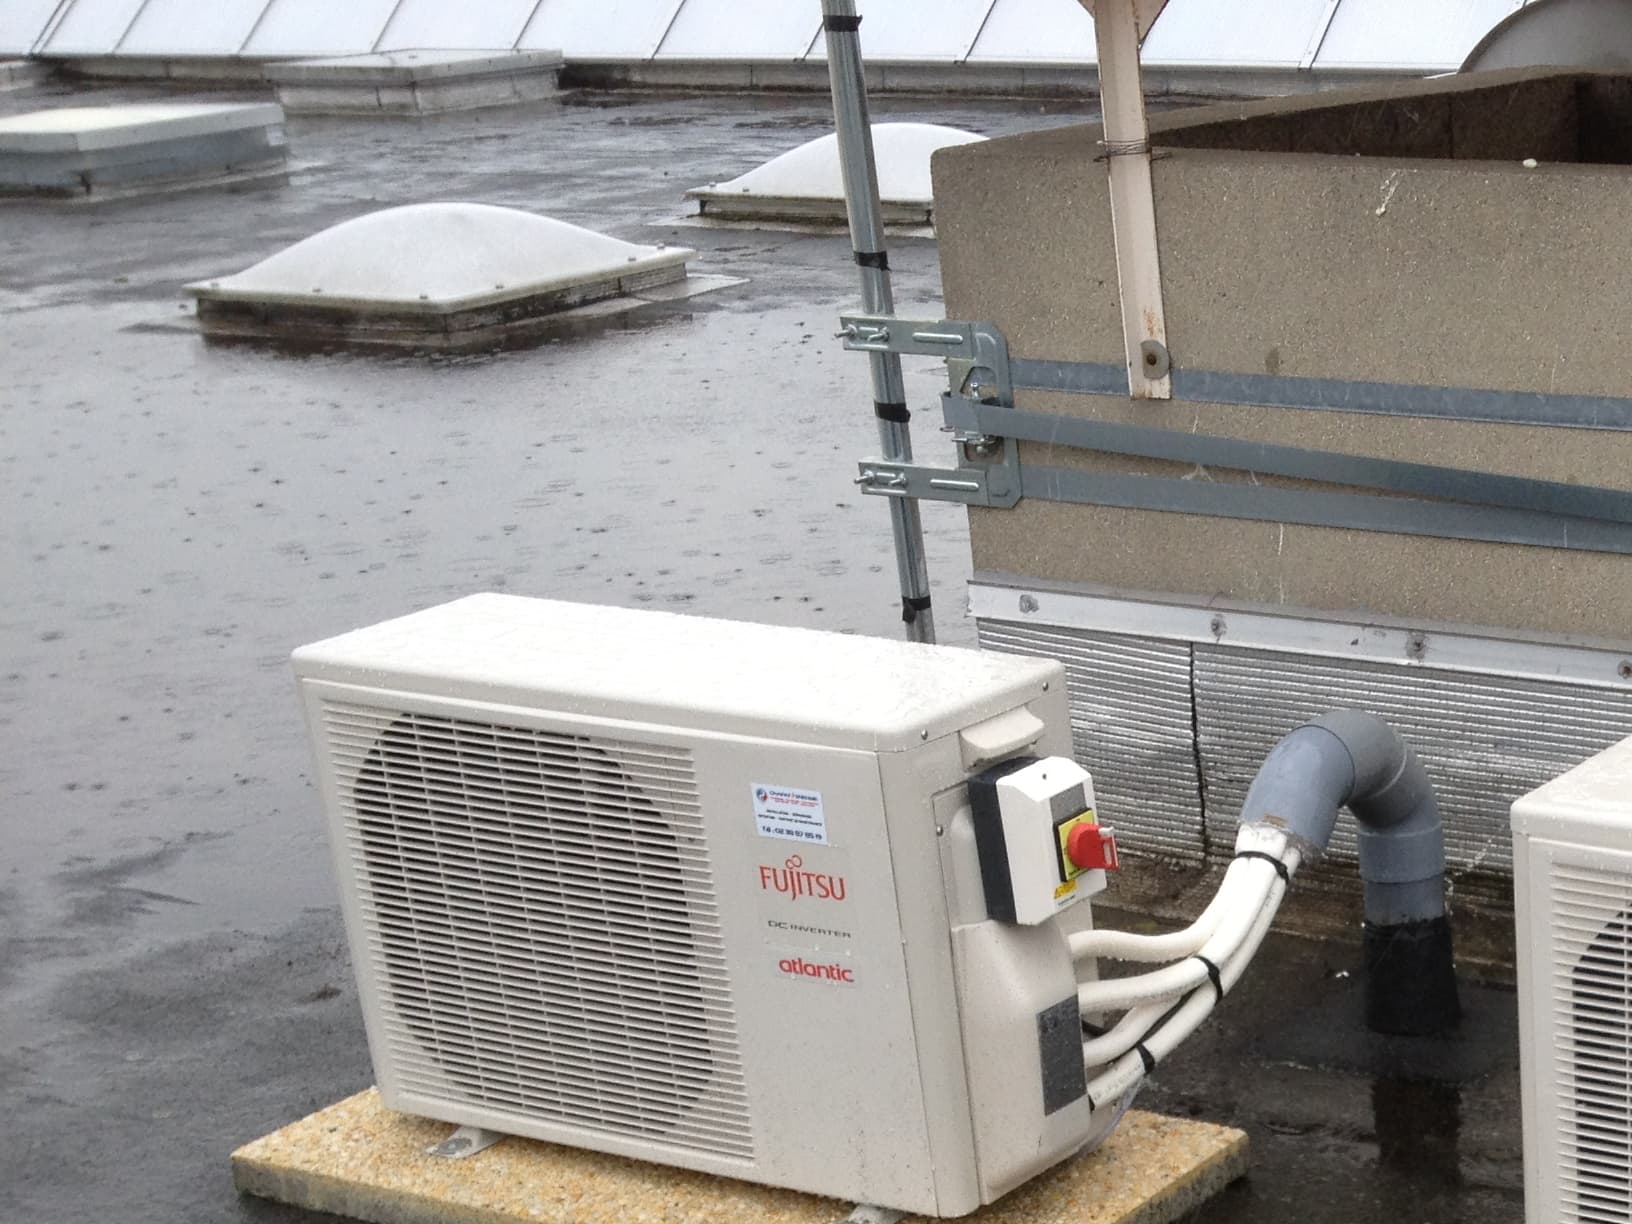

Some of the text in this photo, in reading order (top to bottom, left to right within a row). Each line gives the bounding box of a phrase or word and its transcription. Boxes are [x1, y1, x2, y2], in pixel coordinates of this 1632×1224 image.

[759, 866, 846, 901] FUJITSU
[767, 919, 852, 939] DC INVERTER
[778, 957, 855, 983] atlantic
